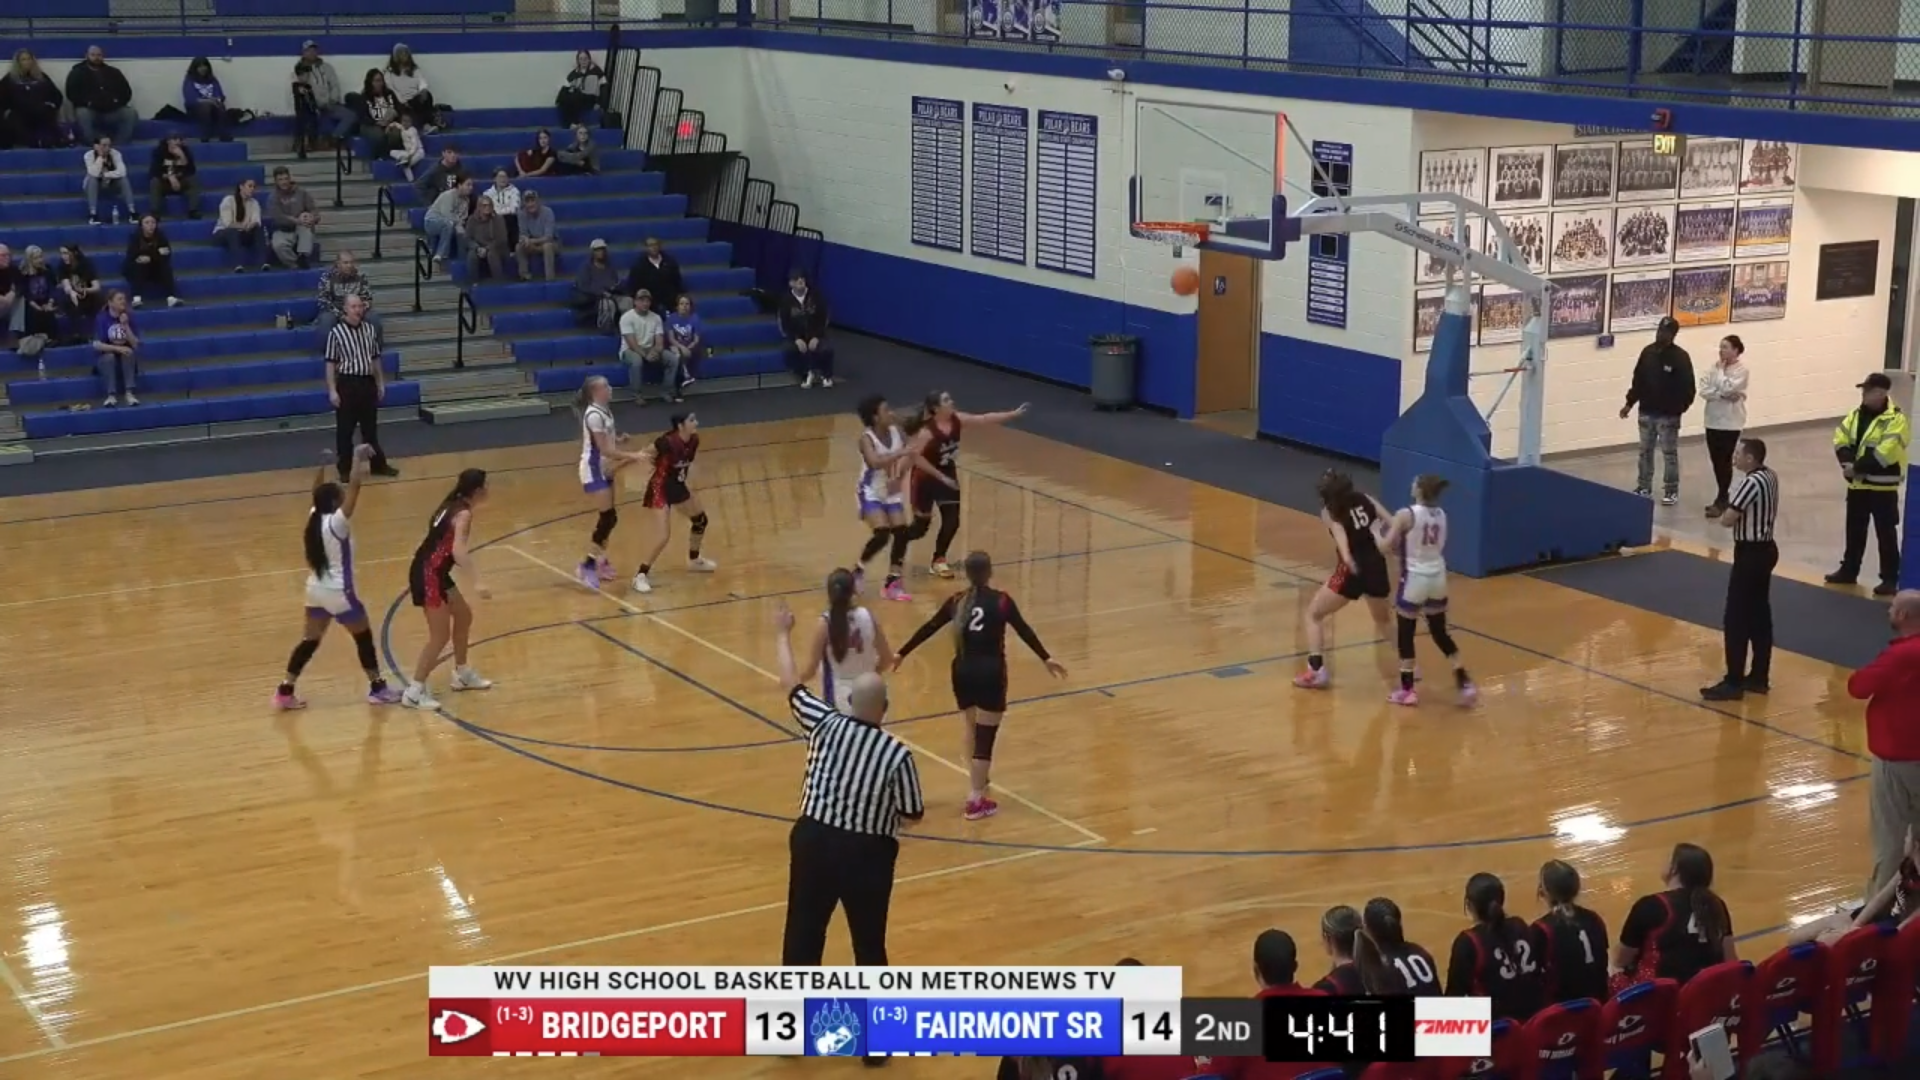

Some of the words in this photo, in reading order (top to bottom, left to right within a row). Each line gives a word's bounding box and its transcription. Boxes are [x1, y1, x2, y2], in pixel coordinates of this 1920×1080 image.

[917, 103, 934, 116] POLAR
[938, 106, 957, 119] BEARS
[978, 110, 995, 123] POLAR
[1002, 113, 1022, 127] BEARS
[1043, 117, 1062, 131] POLAR
[1070, 119, 1091, 135] BEARS
[1654, 134, 1677, 154] EXIT
[1350, 505, 1369, 530] 15
[1422, 522, 1441, 546] 13
[970, 607, 985, 631] 2
[1579, 929, 1594, 964] 1
[1394, 954, 1434, 988] 10
[1494, 940, 1537, 979] 32
